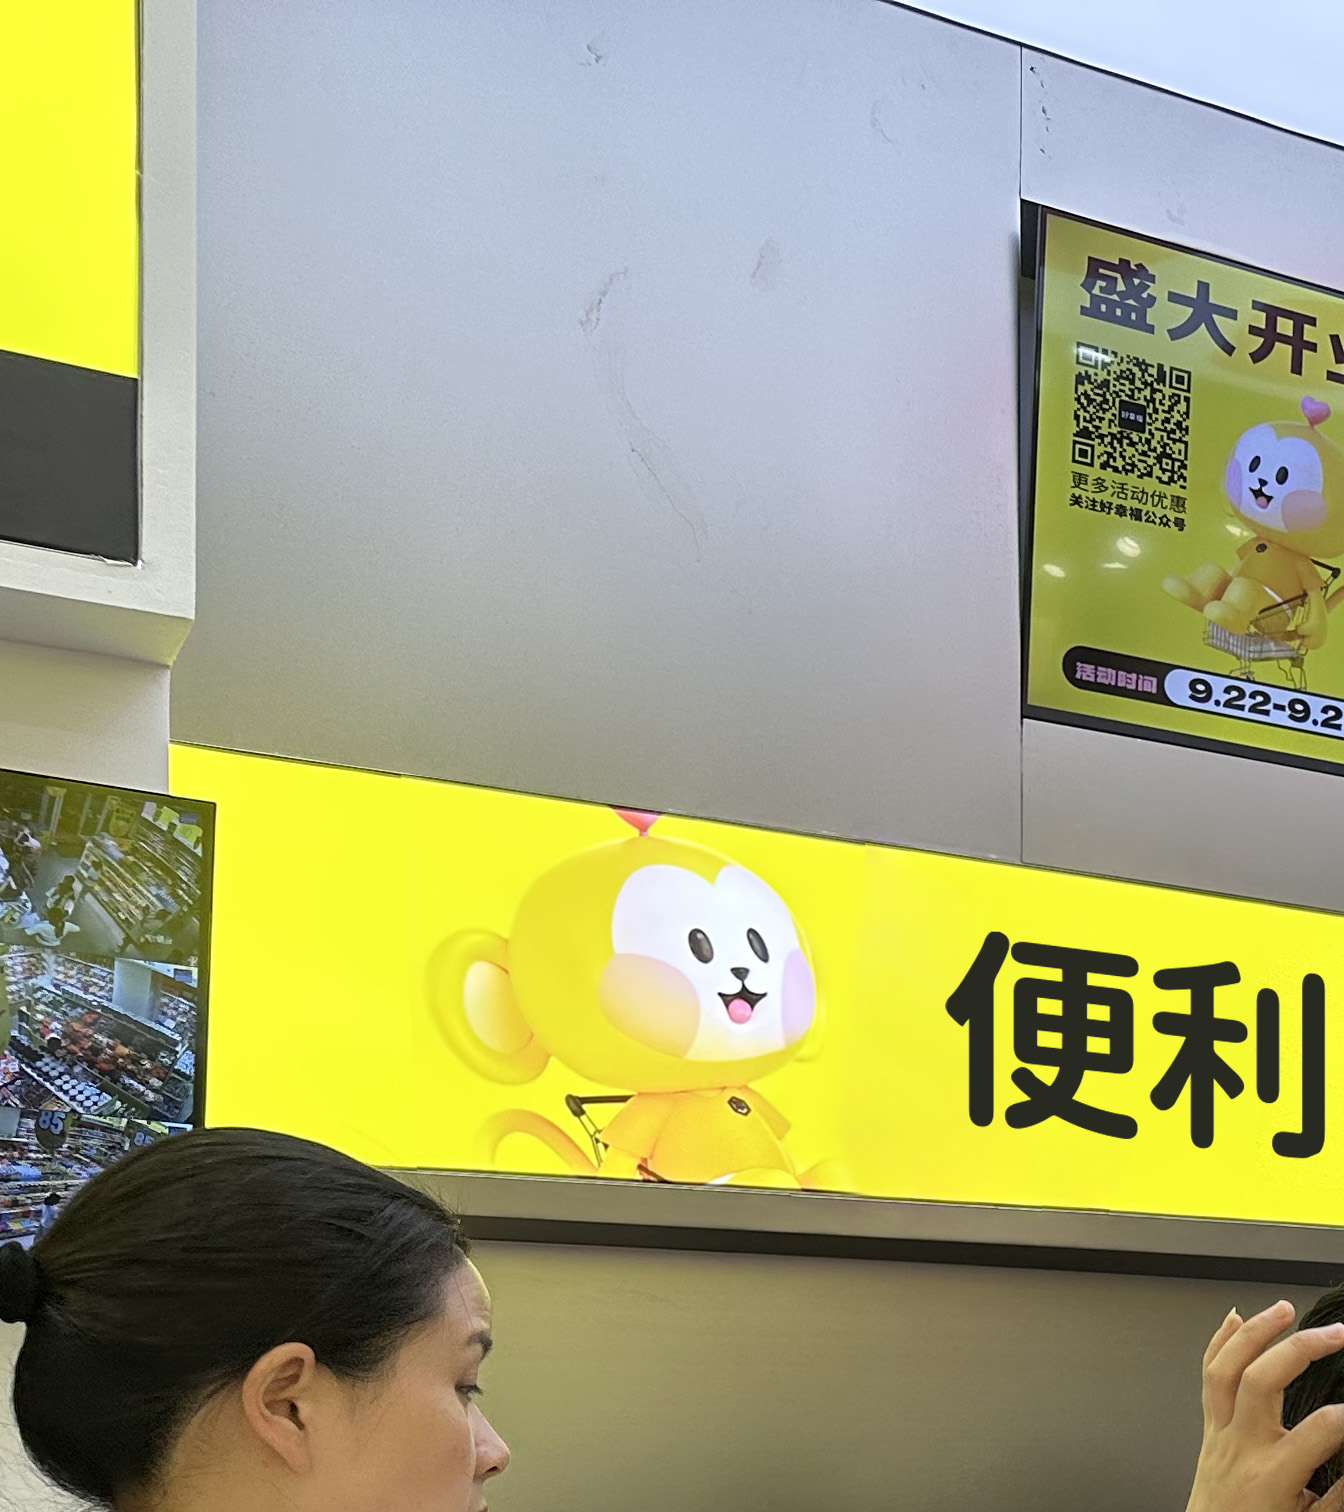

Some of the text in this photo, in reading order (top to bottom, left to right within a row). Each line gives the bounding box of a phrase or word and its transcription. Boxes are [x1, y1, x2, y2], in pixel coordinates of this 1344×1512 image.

[1069, 492, 1187, 532] 关注好幸福公众号
[1070, 470, 1188, 514] 更多活动优惠
[1075, 661, 1159, 694] 活动时间
